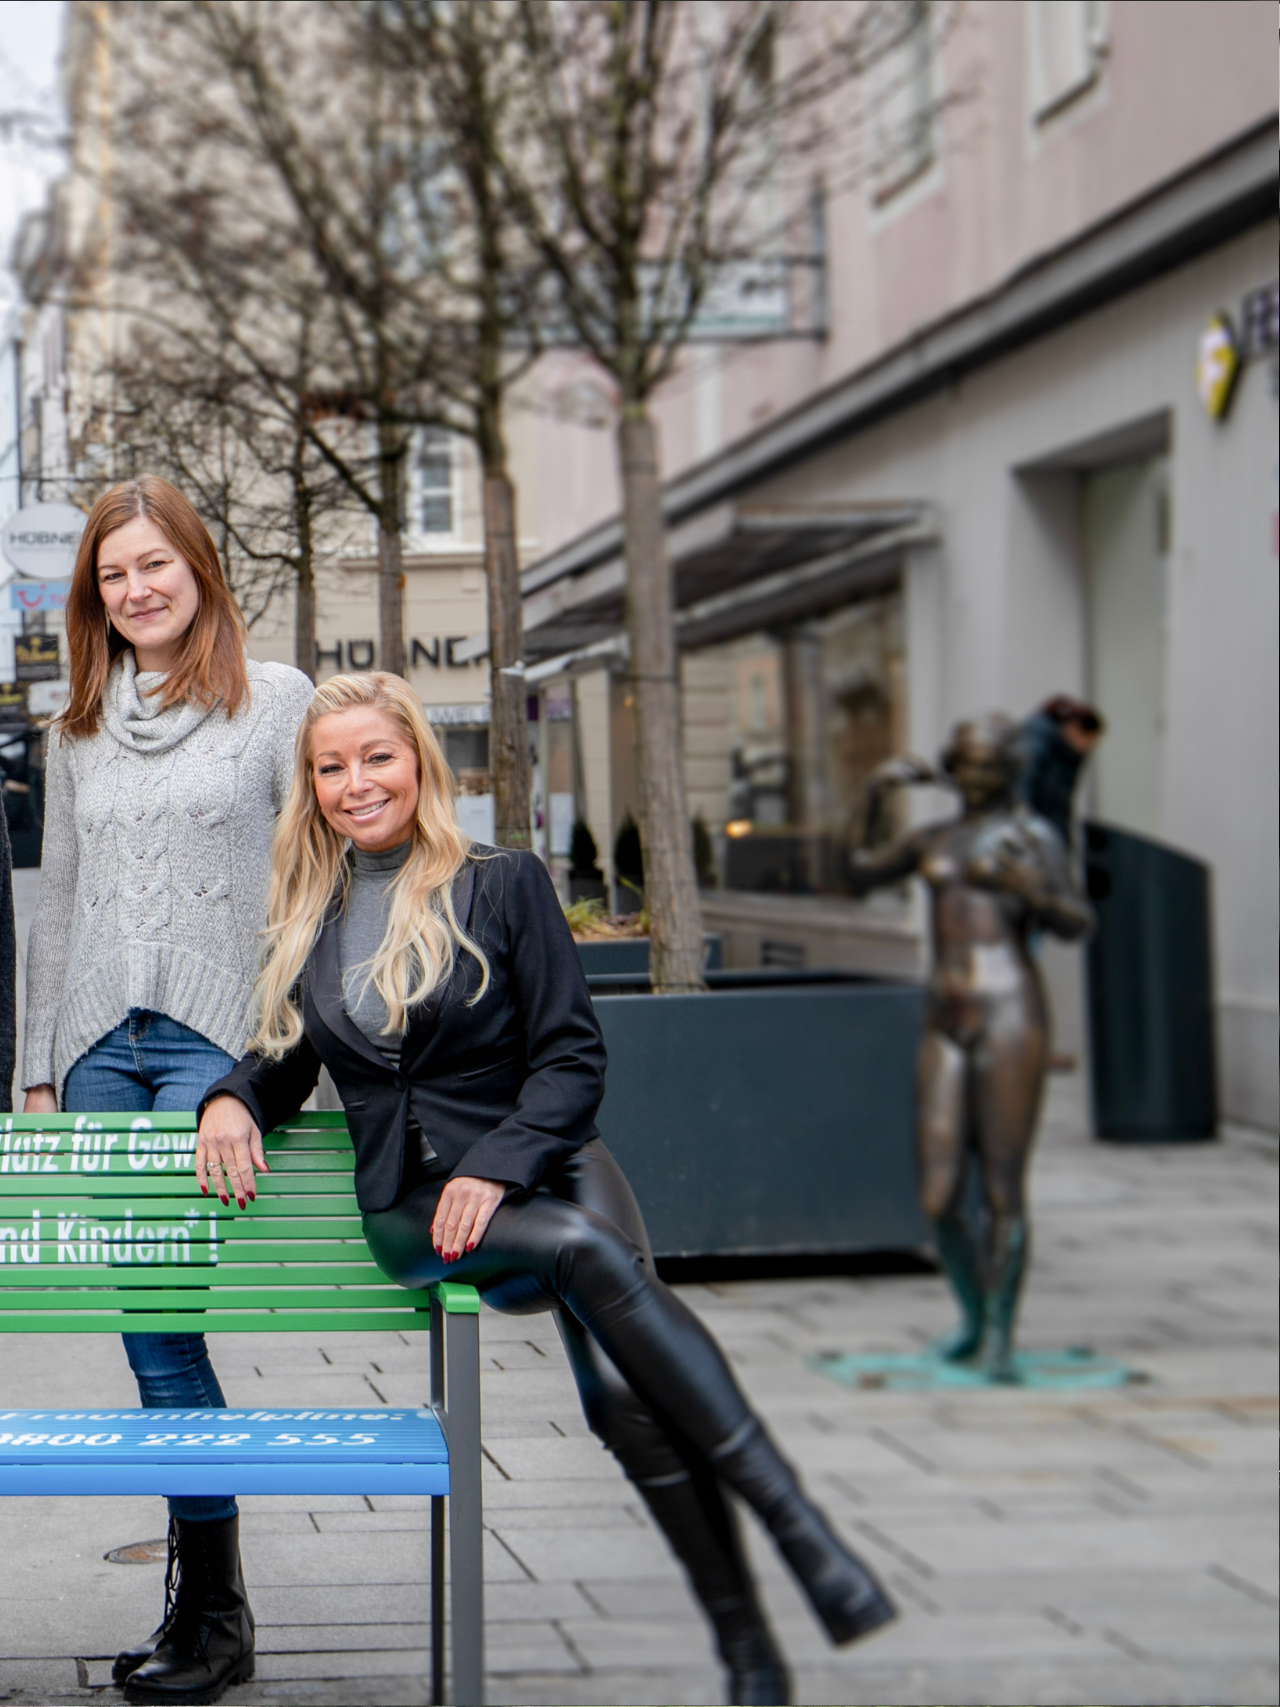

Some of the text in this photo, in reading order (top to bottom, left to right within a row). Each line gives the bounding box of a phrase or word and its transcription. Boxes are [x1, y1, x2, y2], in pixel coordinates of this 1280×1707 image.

[314, 636, 491, 669] HÜNE
[71, 1115, 118, 1171] für
[128, 1117, 197, 1170] Gew
[137, 1433, 251, 1446] 222
[266, 1433, 380, 1446] 555
